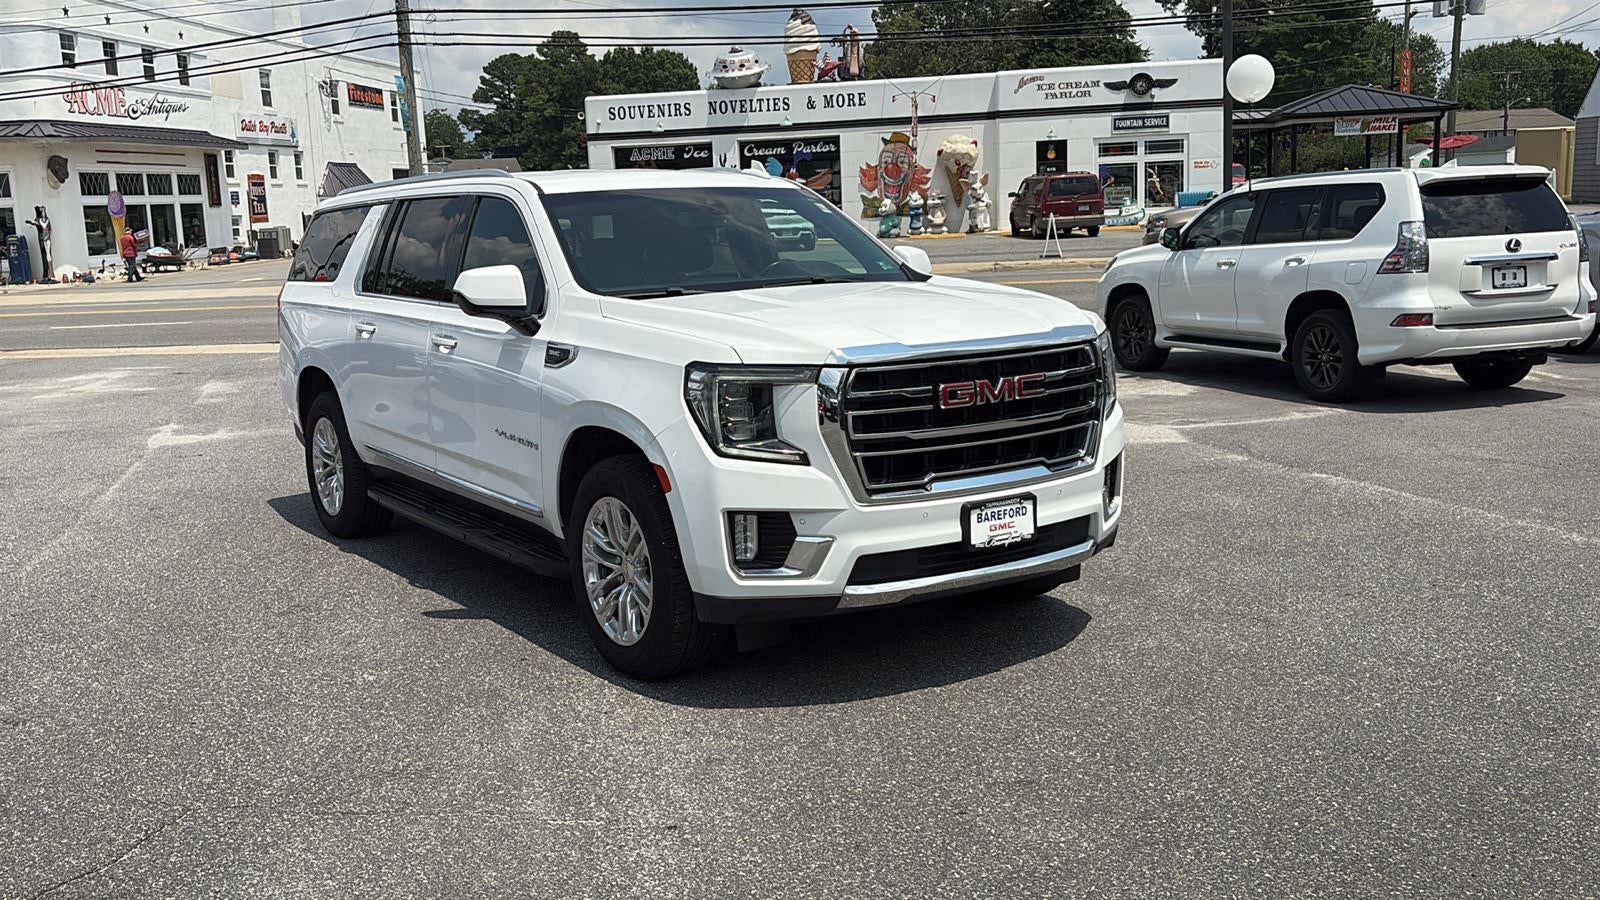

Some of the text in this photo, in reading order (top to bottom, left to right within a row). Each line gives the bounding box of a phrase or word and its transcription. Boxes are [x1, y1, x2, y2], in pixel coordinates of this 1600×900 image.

[1037, 80, 1101, 92] ICE CREAM
[63, 81, 189, 121] ACME Antiques
[1045, 90, 1092, 100] PARLOR
[608, 92, 867, 121] SOUVENIRS NOVELTIES & MORE
[1115, 117, 1168, 128] FOUNTAIN SERVICE
[1372, 115, 1398, 124] MILK
[241, 119, 256, 132] Dutch
[259, 121, 269, 136] Boy
[630, 141, 837, 161] ACME Ice Cream Parlor
[253, 200, 265, 213] TEA
[939, 372, 1047, 409] GMC
[976, 505, 1028, 524] BAREFORD
[989, 520, 1016, 532] GMC
